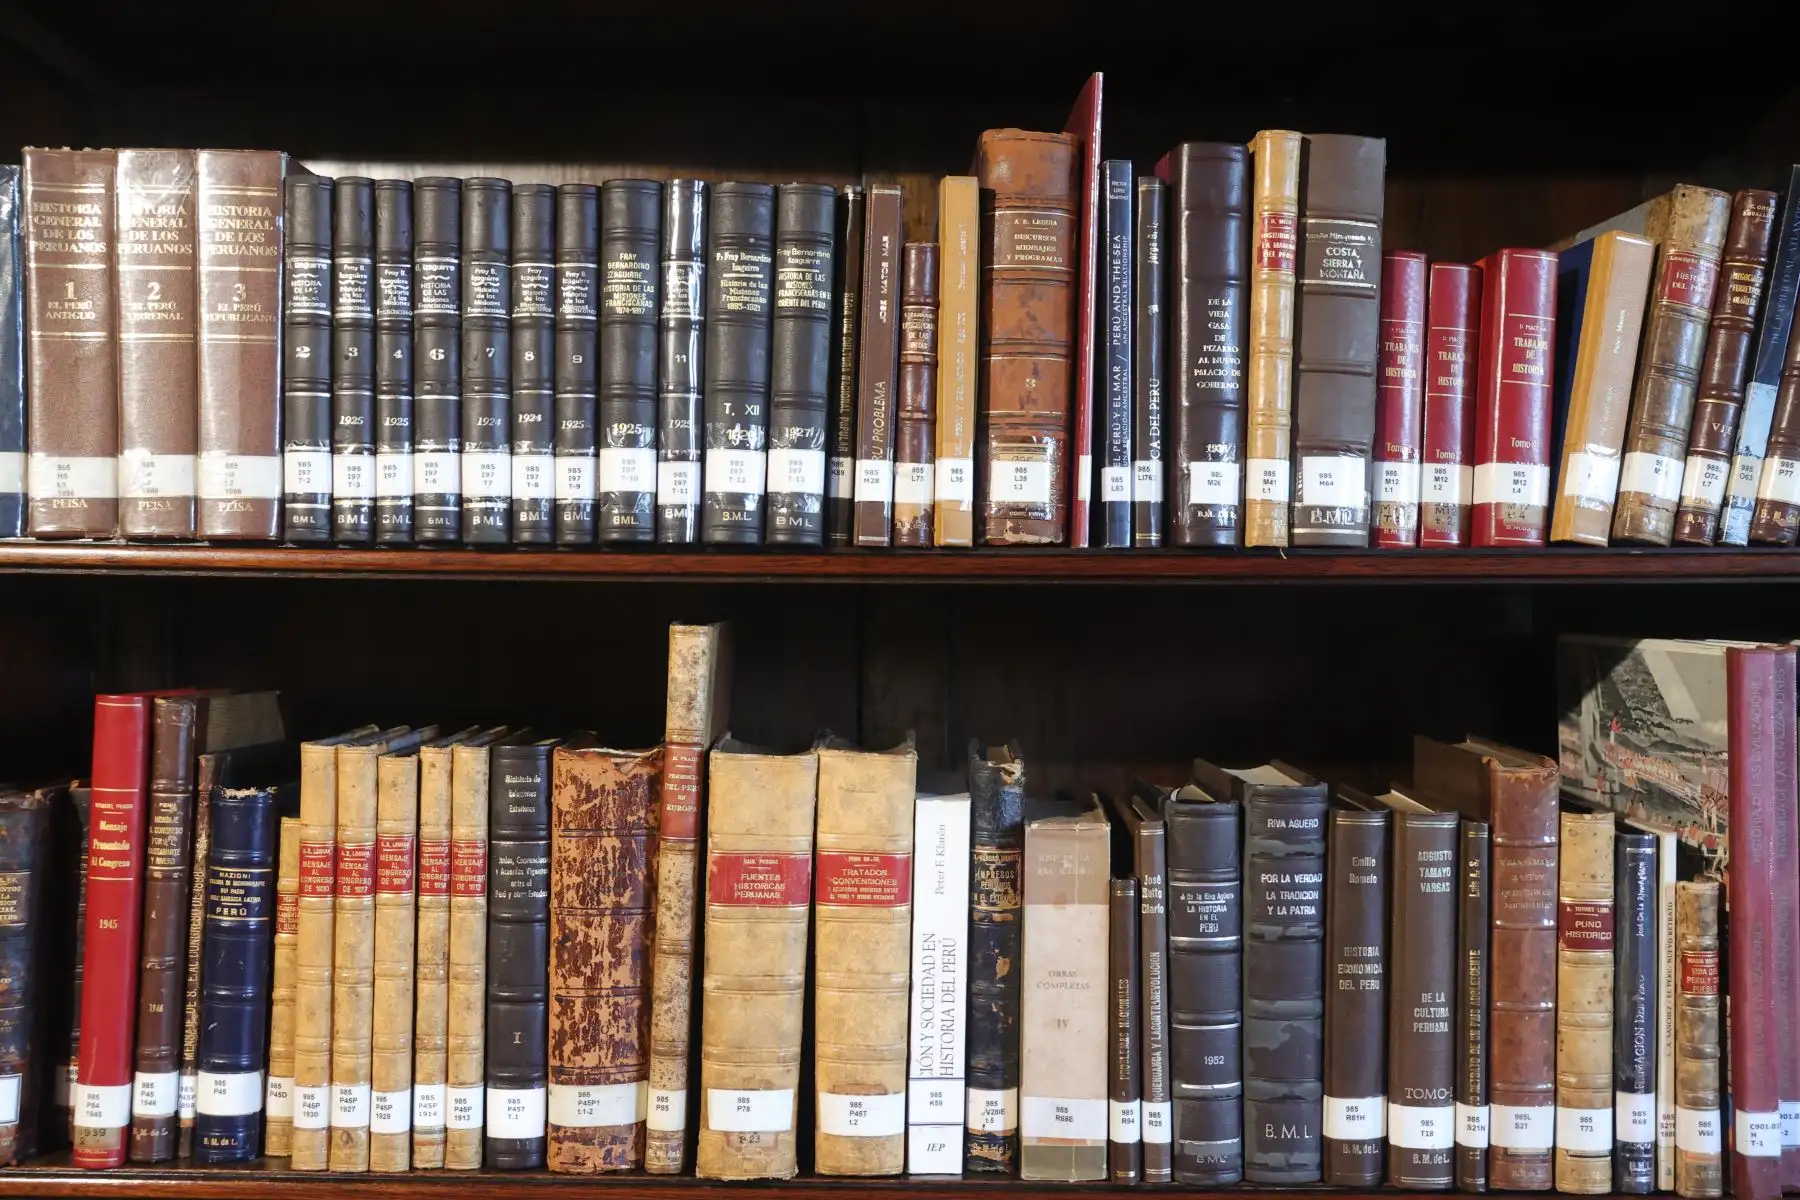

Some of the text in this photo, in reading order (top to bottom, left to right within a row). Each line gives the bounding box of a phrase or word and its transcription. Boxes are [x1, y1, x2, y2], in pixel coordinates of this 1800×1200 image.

[43, 230, 94, 240] DE LOS
[129, 230, 179, 241] DE LOS
[214, 232, 265, 243] DE LOS
[1014, 233, 1057, 242] DISCURSOS
[1112, 234, 1121, 256] SEA
[619, 252, 637, 260] FRAY
[1325, 246, 1360, 259] COSTA,
[607, 262, 650, 271] BERNARDINO
[1112, 257, 1121, 278] THE
[1322, 258, 1363, 268] SIERRA Y
[64, 282, 78, 300] 1
[147, 281, 162, 300] 2
[232, 283, 247, 302] 3
[613, 292, 647, 300] MISIONES
[1112, 286, 1121, 311] AND
[1207, 298, 1233, 306] DE LA
[45, 311, 96, 321] ANTIGUO
[1207, 310, 1230, 318] VIEJA
[1112, 315, 1121, 346] PERÚ
[1214, 334, 1227, 342] DE
[1513, 336, 1548, 351] TRABAJOS
[295, 345, 311, 359] 2
[348, 346, 359, 357] 3
[393, 349, 404, 359] 4
[429, 348, 445, 360] 6
[485, 347, 496, 358] 7
[1202, 345, 1239, 353] PIZARRO
[524, 350, 535, 361] 8
[572, 354, 583, 364] 9
[1212, 357, 1241, 365] NUEVO
[1193, 369, 1241, 377] PALACIO DE
[1385, 367, 1417, 379] HISTORIA
[1512, 363, 1544, 376] HISTORIA
[1112, 364, 1121, 392] MAR
[1196, 382, 1240, 390] GOBIERNO
[1112, 394, 1121, 409] EL
[744, 403, 760, 416] XII
[872, 380, 887, 443] PROBLEMA
[339, 415, 364, 425] 1925
[384, 417, 409, 427] 1925
[476, 416, 502, 426] 1924
[517, 413, 542, 423] 1924
[1113, 412, 1121, 422] Y
[561, 420, 585, 430] 1925
[1112, 423, 1121, 453] PERÚ
[1780, 460, 1795, 468] 985
[1385, 469, 1398, 477] 985
[1434, 467, 1447, 475] 985
[1513, 470, 1526, 478] 985
[1778, 469, 1794, 477] P77
[1433, 475, 1448, 483] M12
[1512, 478, 1527, 486] M12
[1267, 818, 1319, 829] RIVA AGUERO
[380, 854, 410, 862] MENSAJE
[1417, 850, 1453, 861] AUGUSTO
[339, 862, 369, 871] MENSAJE
[420, 857, 450, 867] MENSAJE
[453, 857, 484, 866] MENSAJE
[1352, 856, 1377, 867] Emilio
[219, 871, 251, 879] NAZIONI
[841, 868, 888, 877] TRATADOS
[1418, 866, 1452, 878] TAMAYO
[338, 877, 372, 885] CONGRESO
[453, 873, 486, 882] CONGRESO
[740, 873, 781, 882] FUENTES
[832, 877, 898, 886] CONVENSIONES
[1143, 874, 1162, 885] José
[1260, 873, 1323, 883] POR LA VERDAD
[734, 882, 786, 891] HISTORICAS
[1419, 882, 1451, 893] VARGAS
[1265, 890, 1319, 900] LA TRADICION
[215, 906, 247, 916] PERÚ
[1187, 905, 1228, 913] LA HISTORIA
[1267, 905, 1316, 915] Y LA PATRIA
[99, 918, 118, 929] 1945
[1199, 923, 1219, 933] PERU
[1575, 920, 1602, 928] PUNO
[1565, 931, 1612, 940] HISTORICO
[1343, 946, 1380, 957] HISTORIA
[1666, 937, 1674, 964] NUEVO
[1337, 963, 1383, 974] ECONOMICA
[1048, 970, 1078, 978] OBRAS
[920, 931, 936, 1029] SOCIEDAD EN
[1338, 979, 1380, 990] DEL PERU
[1036, 981, 1090, 991] COMPLETAS
[1421, 992, 1446, 1003] DE LA
[938, 937, 957, 1077] HISTORIA DEL PERÚ
[1413, 1007, 1450, 1018] CULTURA
[1413, 1021, 1449, 1032] PERUANA
[1204, 1055, 1225, 1066] 1952
[339, 1088, 353, 1096] 985
[930, 1091, 943, 1099] 985
[339, 1096, 358, 1104] P45P
[375, 1095, 388, 1103] 985
[454, 1097, 468, 1105] 985
[339, 1105, 356, 1113] 1927
[454, 1105, 473, 1113] P45P
[849, 1101, 863, 1109] 985
[1055, 1106, 1069, 1114] 985
[1148, 1111, 1162, 1119] 985
[1466, 1115, 1480, 1123] 985
[1148, 1119, 1163, 1127] R25
[1420, 1119, 1434, 1127] 985
[1466, 1124, 1486, 1132] S21N
[926, 1143, 946, 1152] IEP
